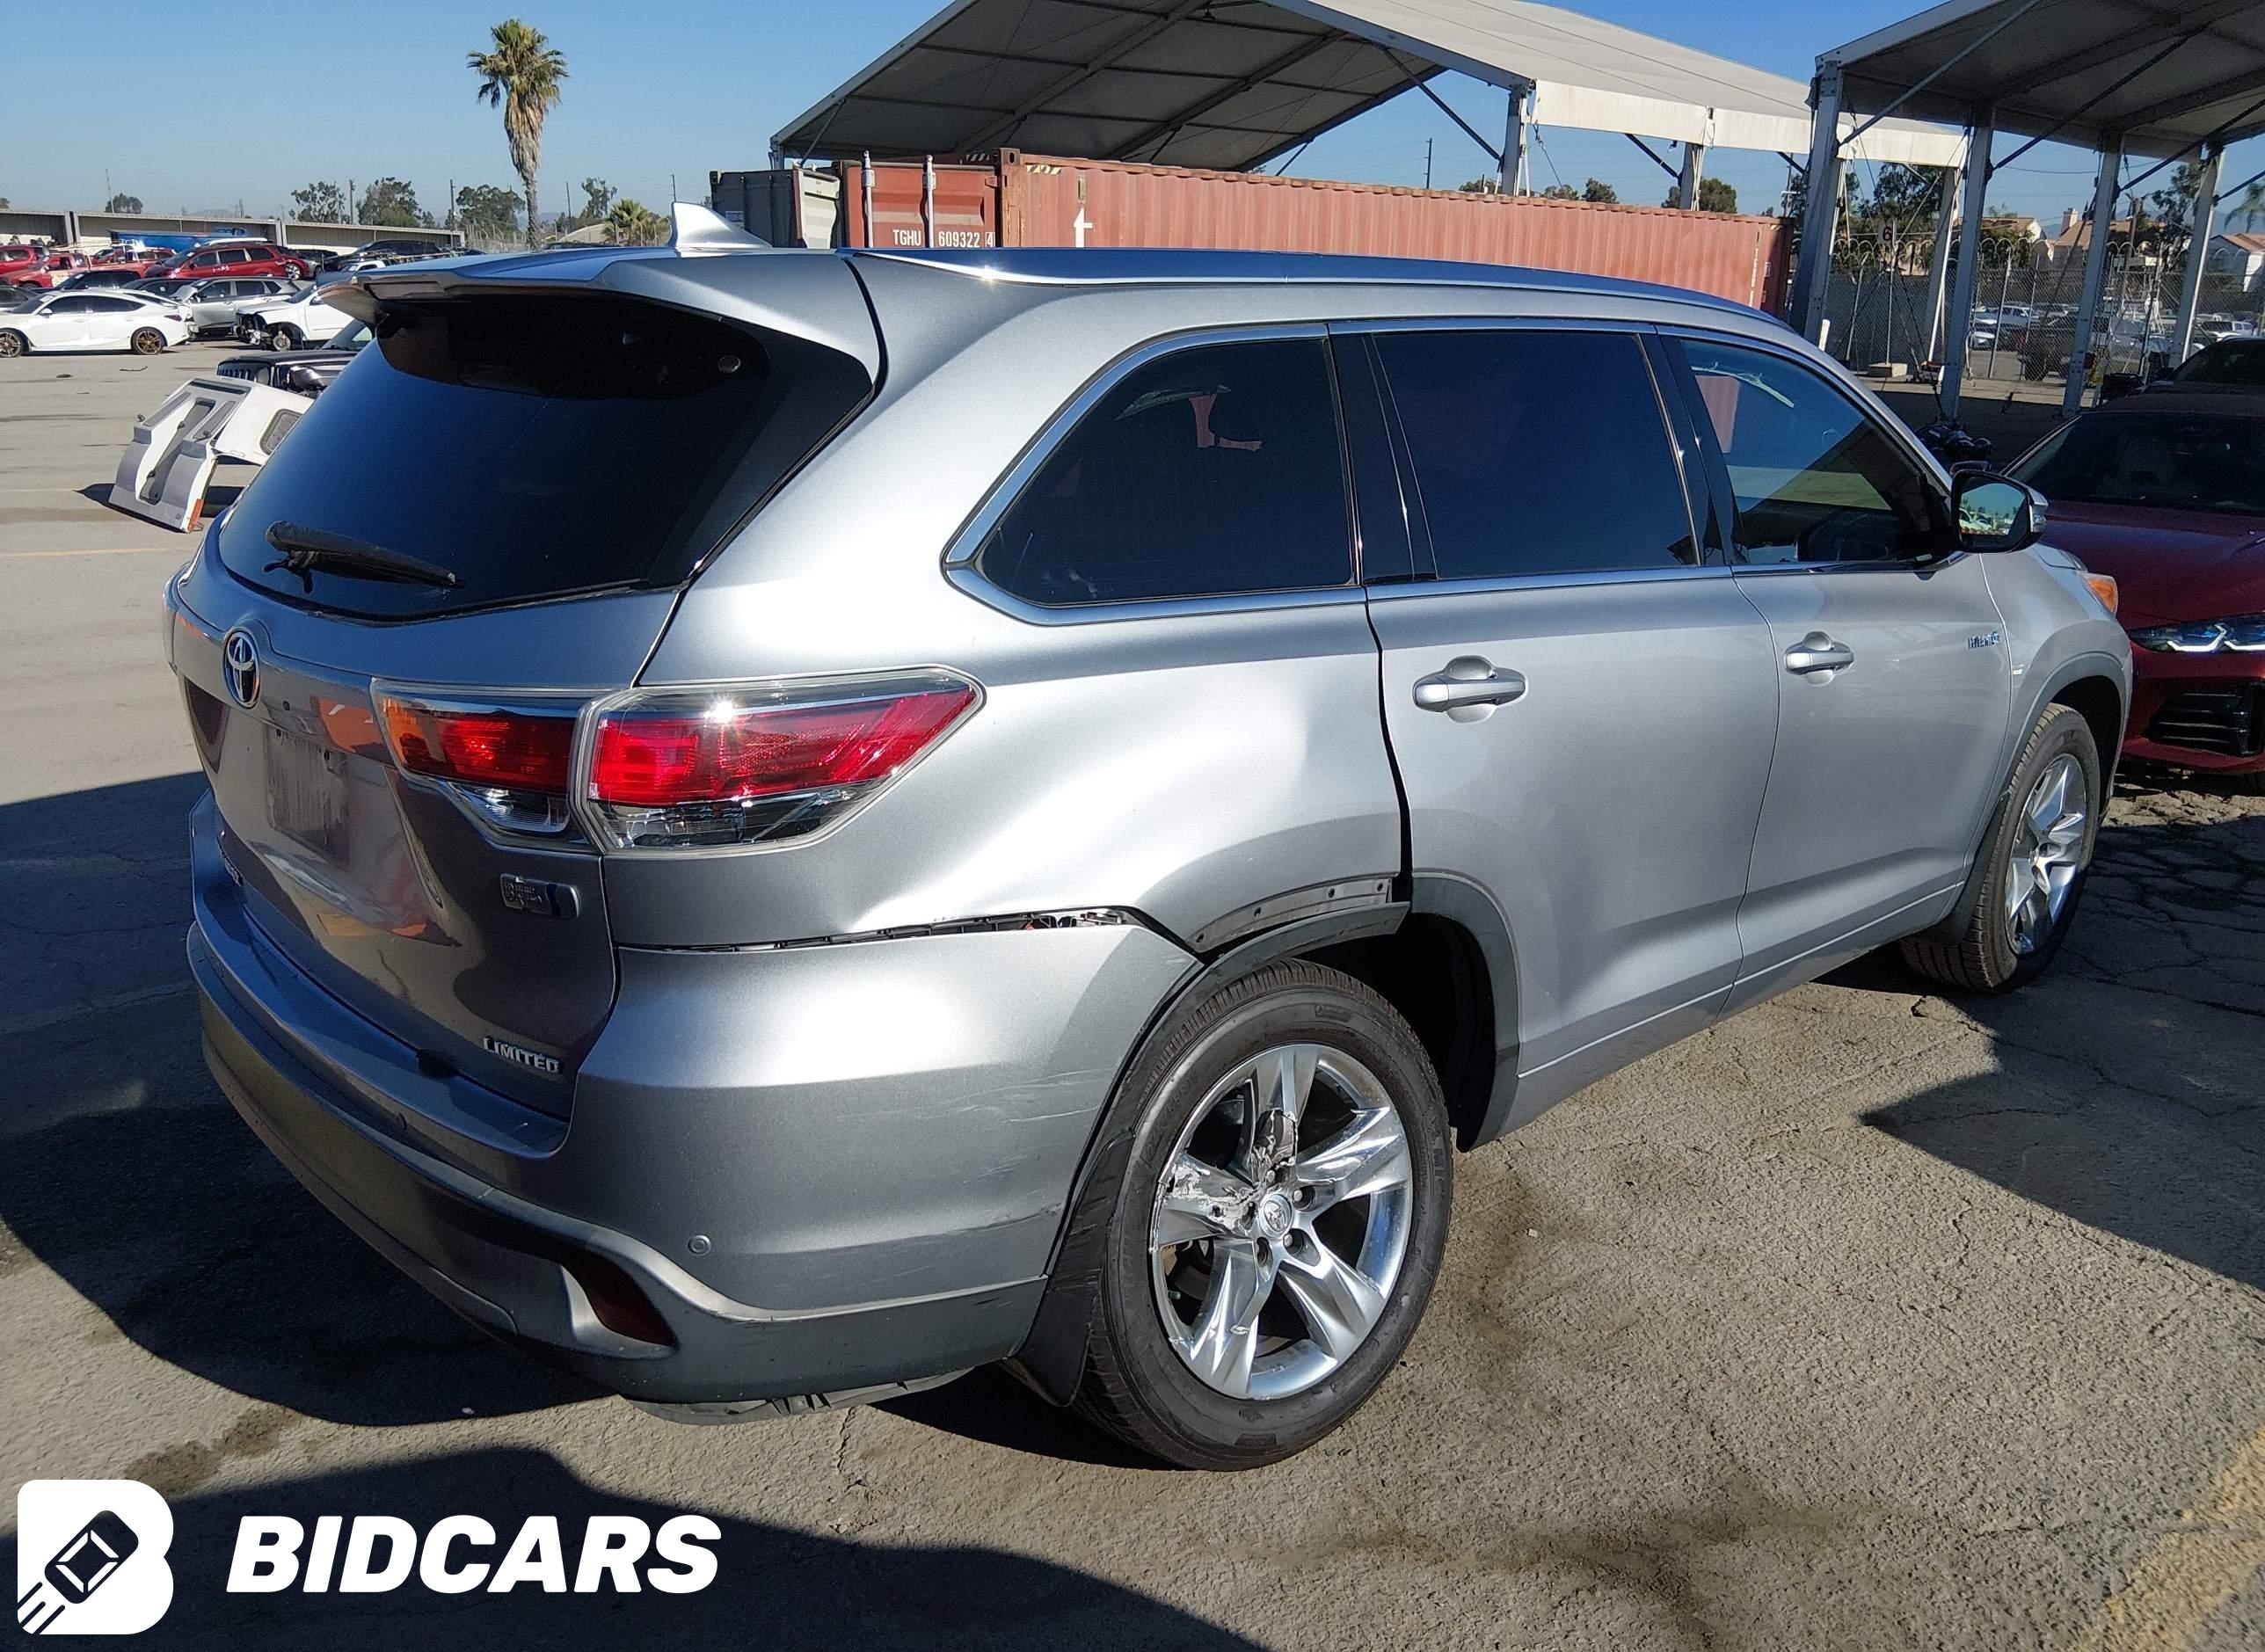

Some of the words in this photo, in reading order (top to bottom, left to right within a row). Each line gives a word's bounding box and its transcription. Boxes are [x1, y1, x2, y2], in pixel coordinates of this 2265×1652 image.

[892, 229, 921, 246] TGHU
[938, 231, 980, 248] 609322
[986, 232, 994, 248] 4
[1883, 226, 1893, 241] 6
[483, 1037, 560, 1073] LIMITED
